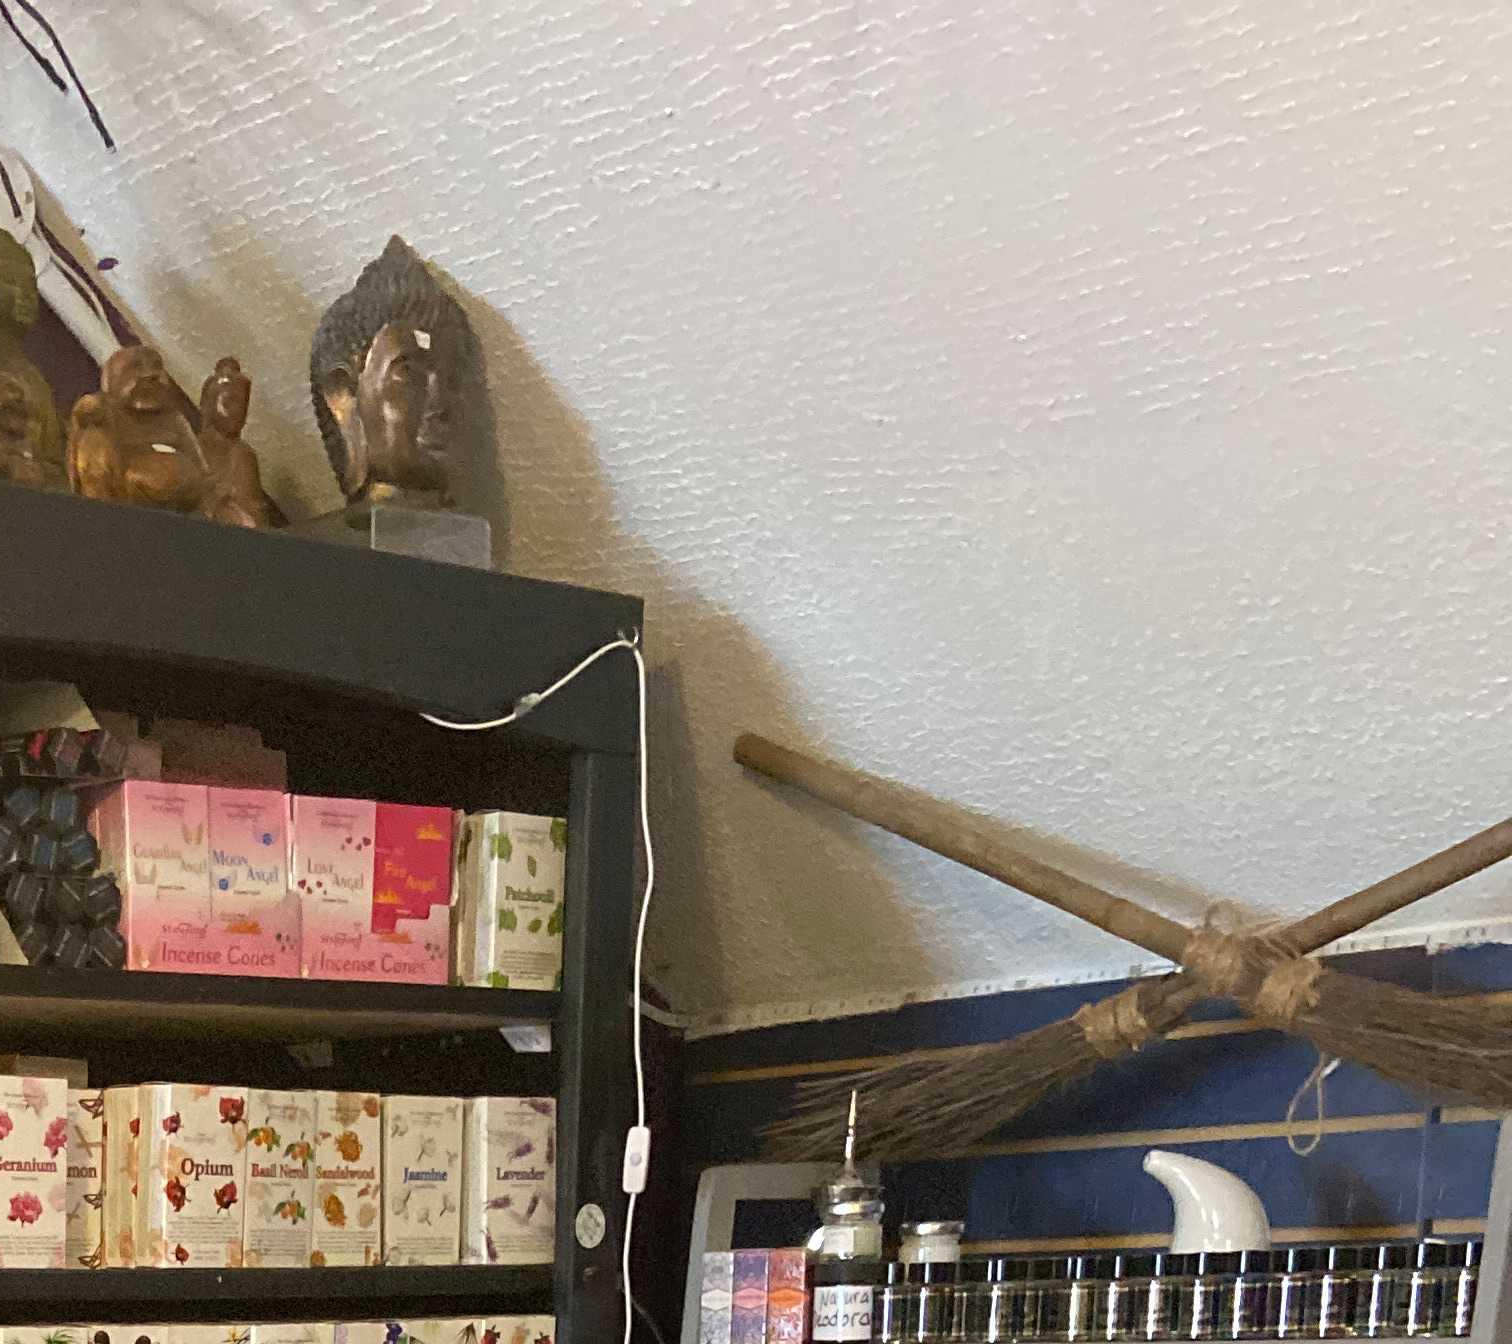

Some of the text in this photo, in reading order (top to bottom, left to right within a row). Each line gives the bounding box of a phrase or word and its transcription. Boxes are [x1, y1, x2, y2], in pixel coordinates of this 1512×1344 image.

[212, 849, 248, 867] Moon
[307, 858, 336, 874] Love
[246, 865, 278, 883] Angel
[331, 872, 364, 890] Angel
[161, 942, 276, 967] Incense Cones
[319, 950, 426, 974] Incense Cones
[180, 1158, 234, 1178] Opium
[316, 1166, 375, 1180] Sandalwood
[403, 1167, 448, 1183] Jasmine
[496, 1167, 547, 1181] Lavender
